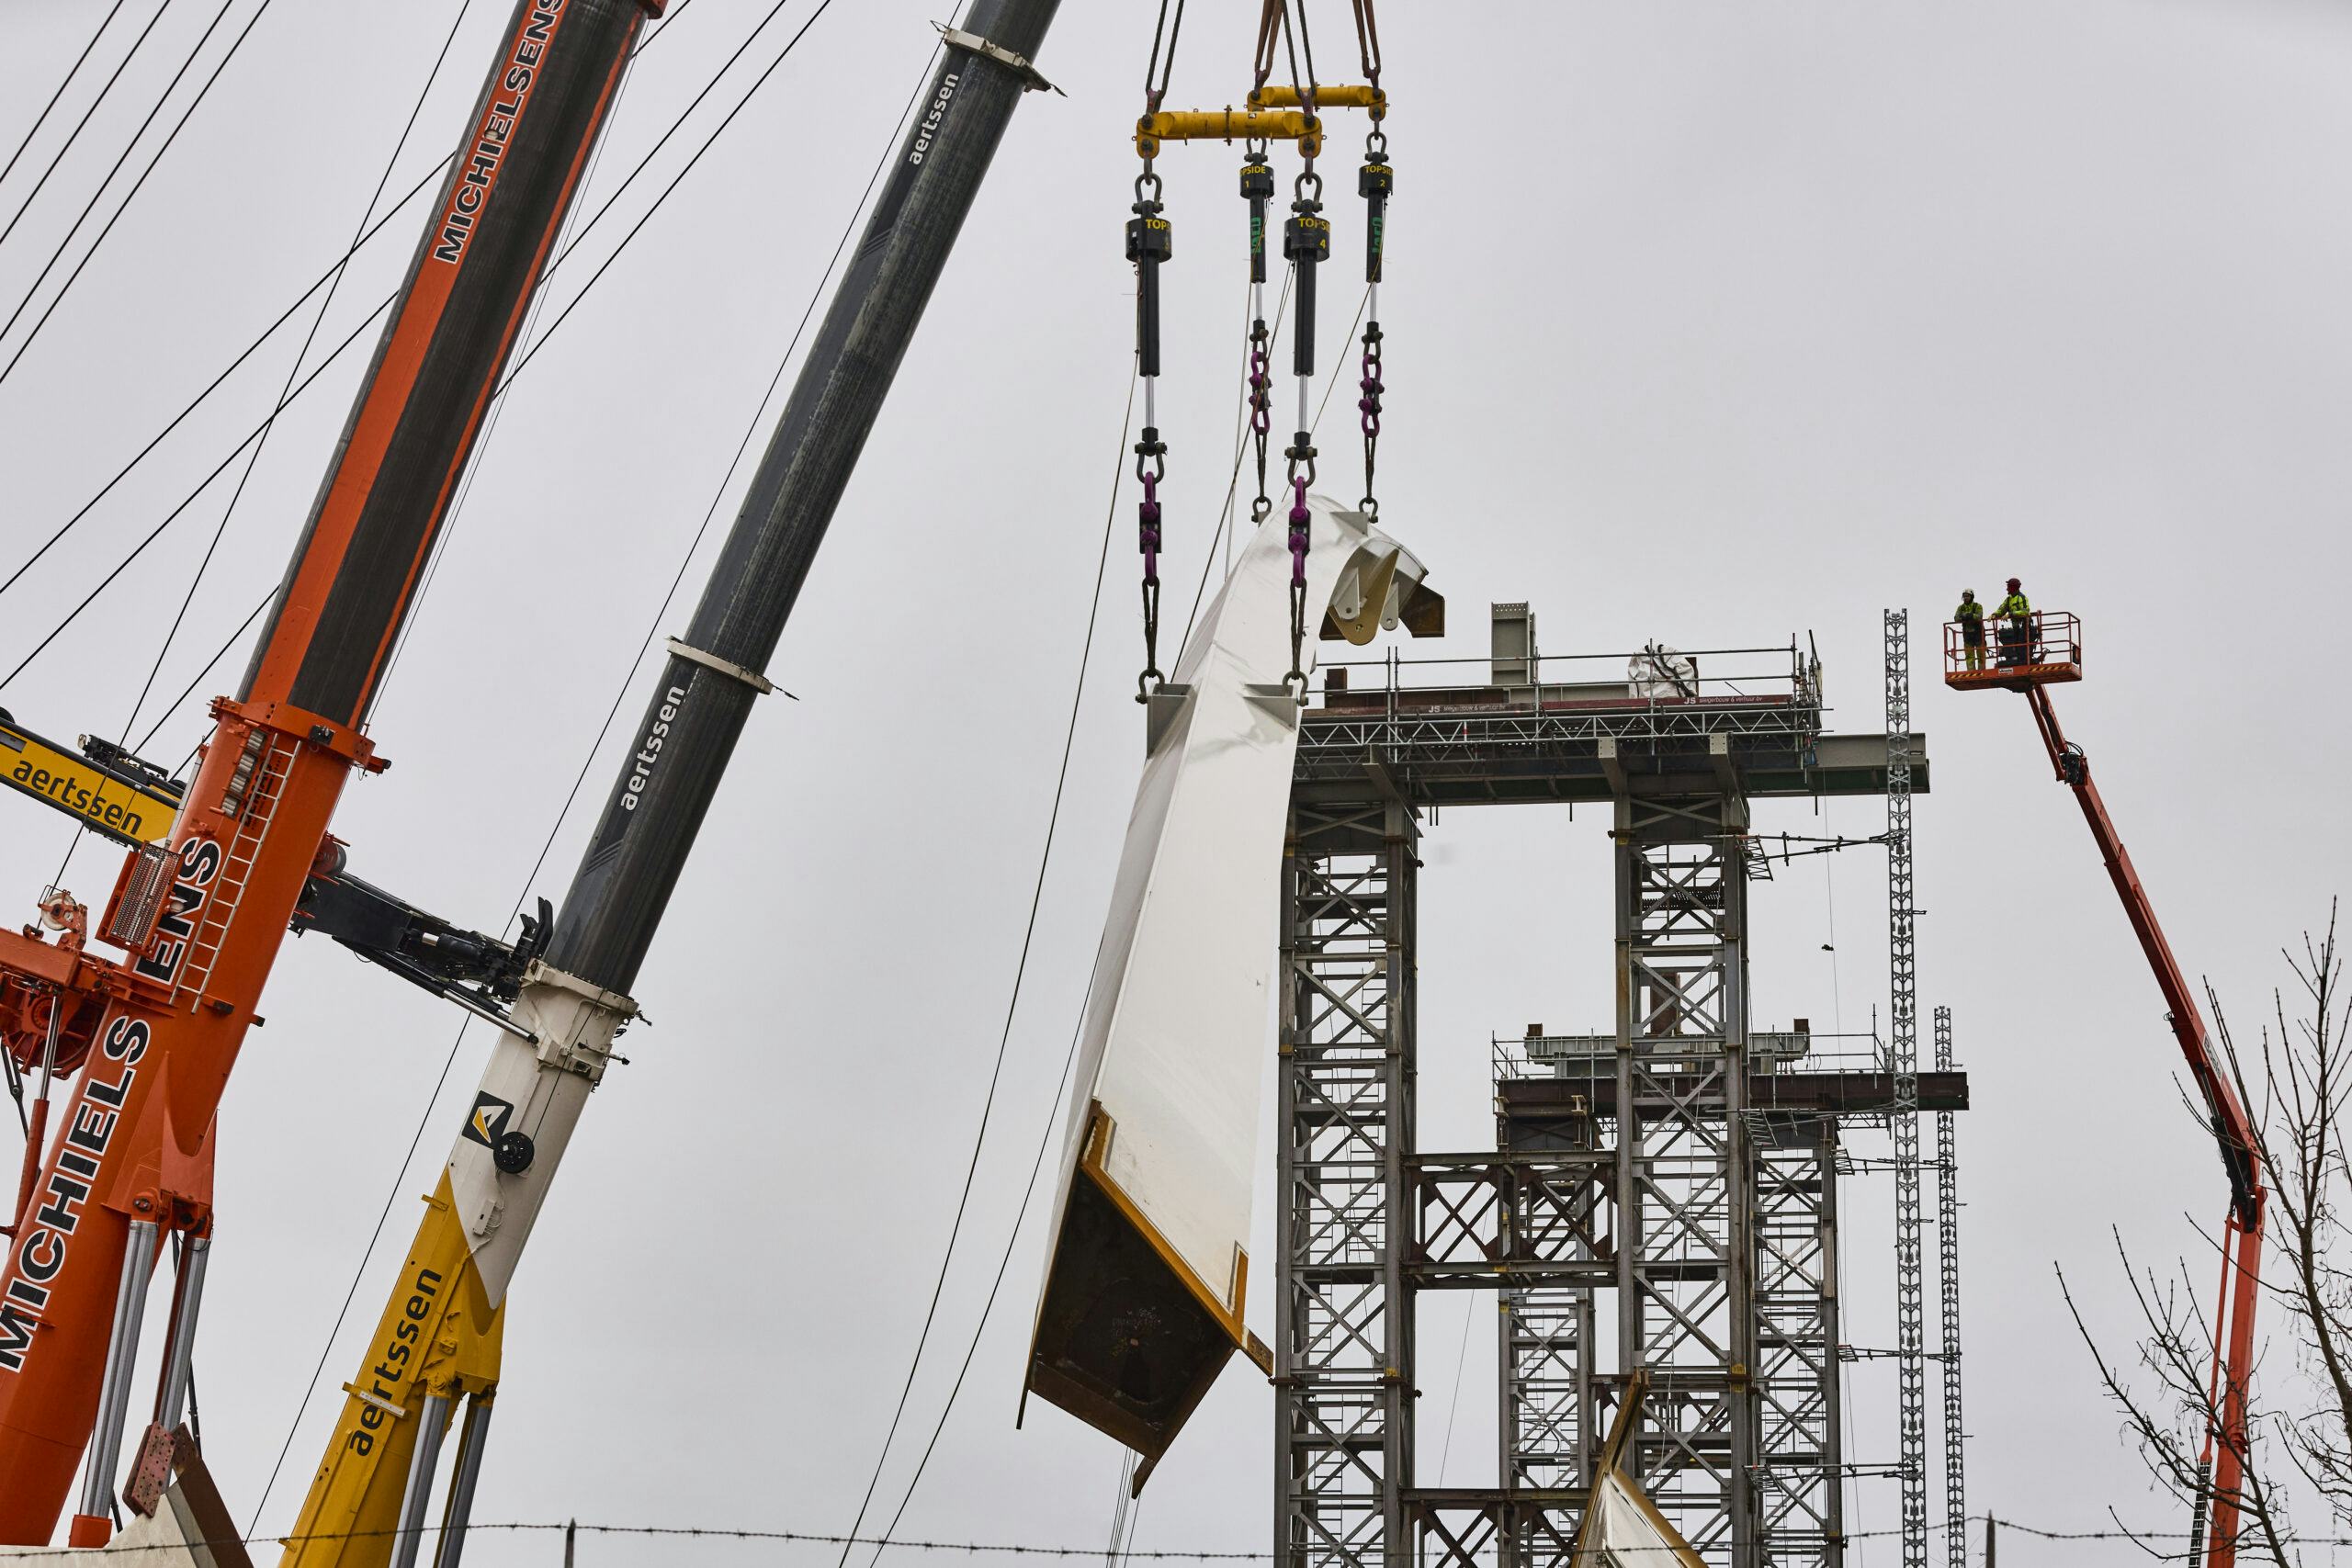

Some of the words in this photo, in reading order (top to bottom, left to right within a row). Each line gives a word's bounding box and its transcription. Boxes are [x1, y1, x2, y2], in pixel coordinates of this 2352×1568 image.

[910, 73, 958, 165] aertssen
[1380, 179, 1385, 187] 2
[1319, 239, 1326, 249] 4
[620, 686, 684, 811] aertssen
[13, 760, 142, 836] aertssen
[349, 1269, 443, 1457] aertssen
